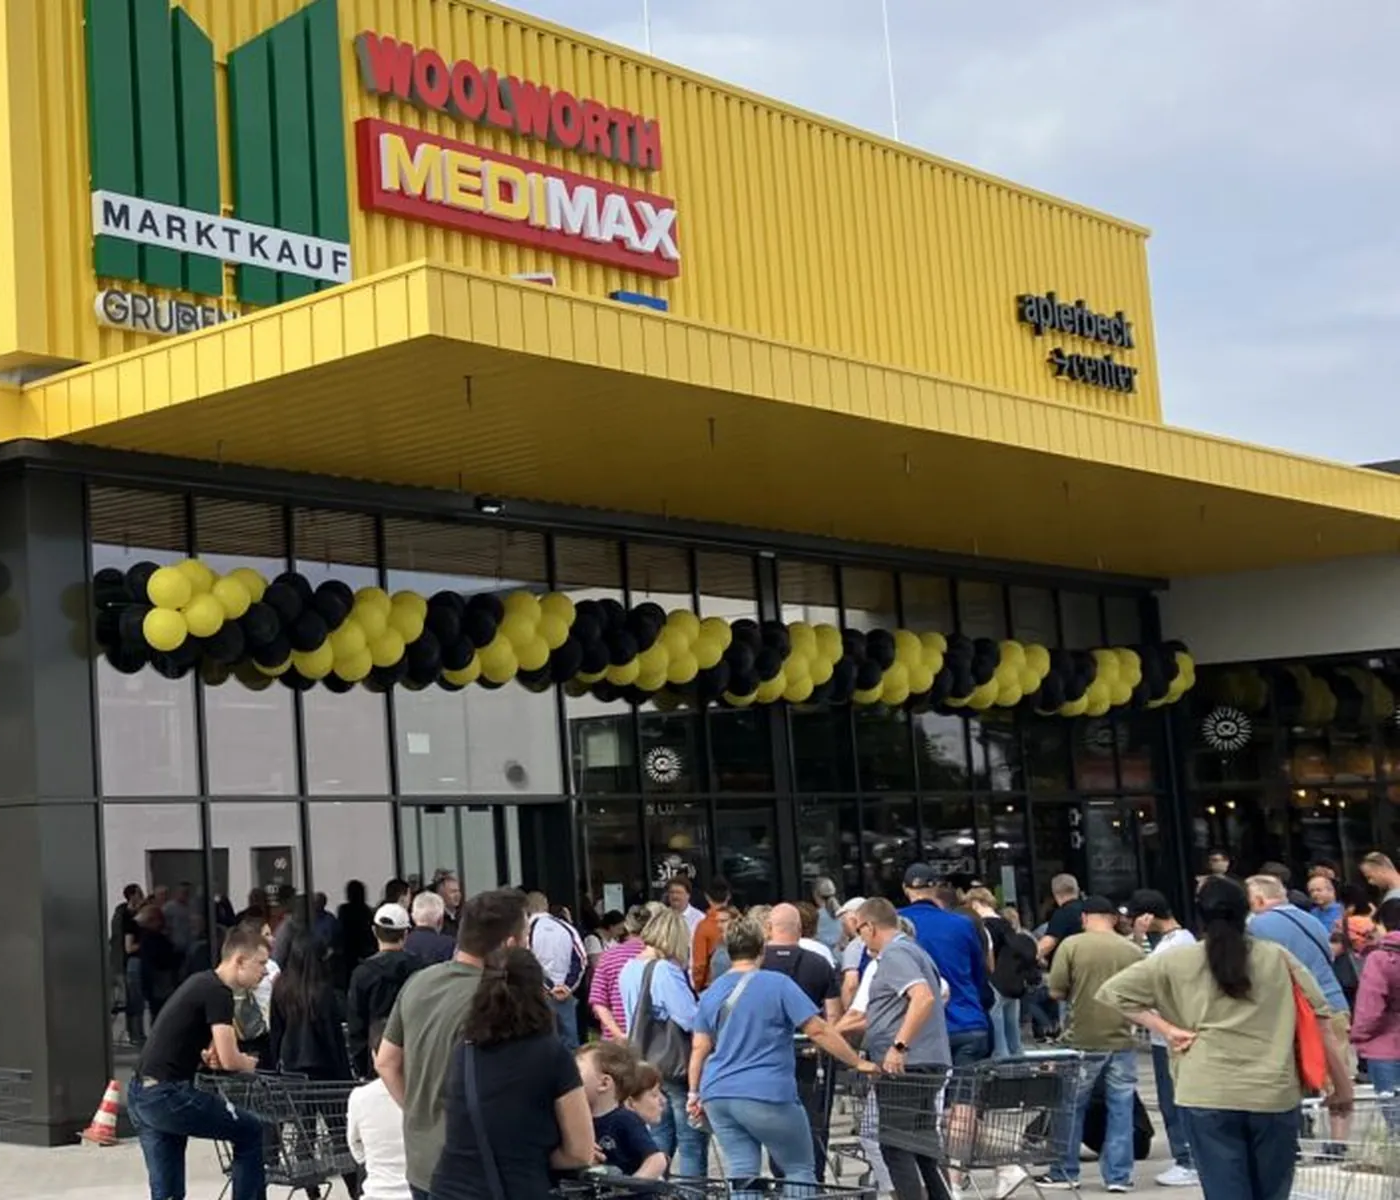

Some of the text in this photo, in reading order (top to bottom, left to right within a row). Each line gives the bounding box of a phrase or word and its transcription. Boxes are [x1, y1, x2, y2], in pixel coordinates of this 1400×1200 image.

[362, 31, 660, 169] WOOLWORTH
[380, 132, 680, 259] MEDIMAX
[103, 200, 348, 275] MARKTKAUF
[1018, 292, 1134, 348] aplerbeck
[1070, 354, 1137, 393] center
